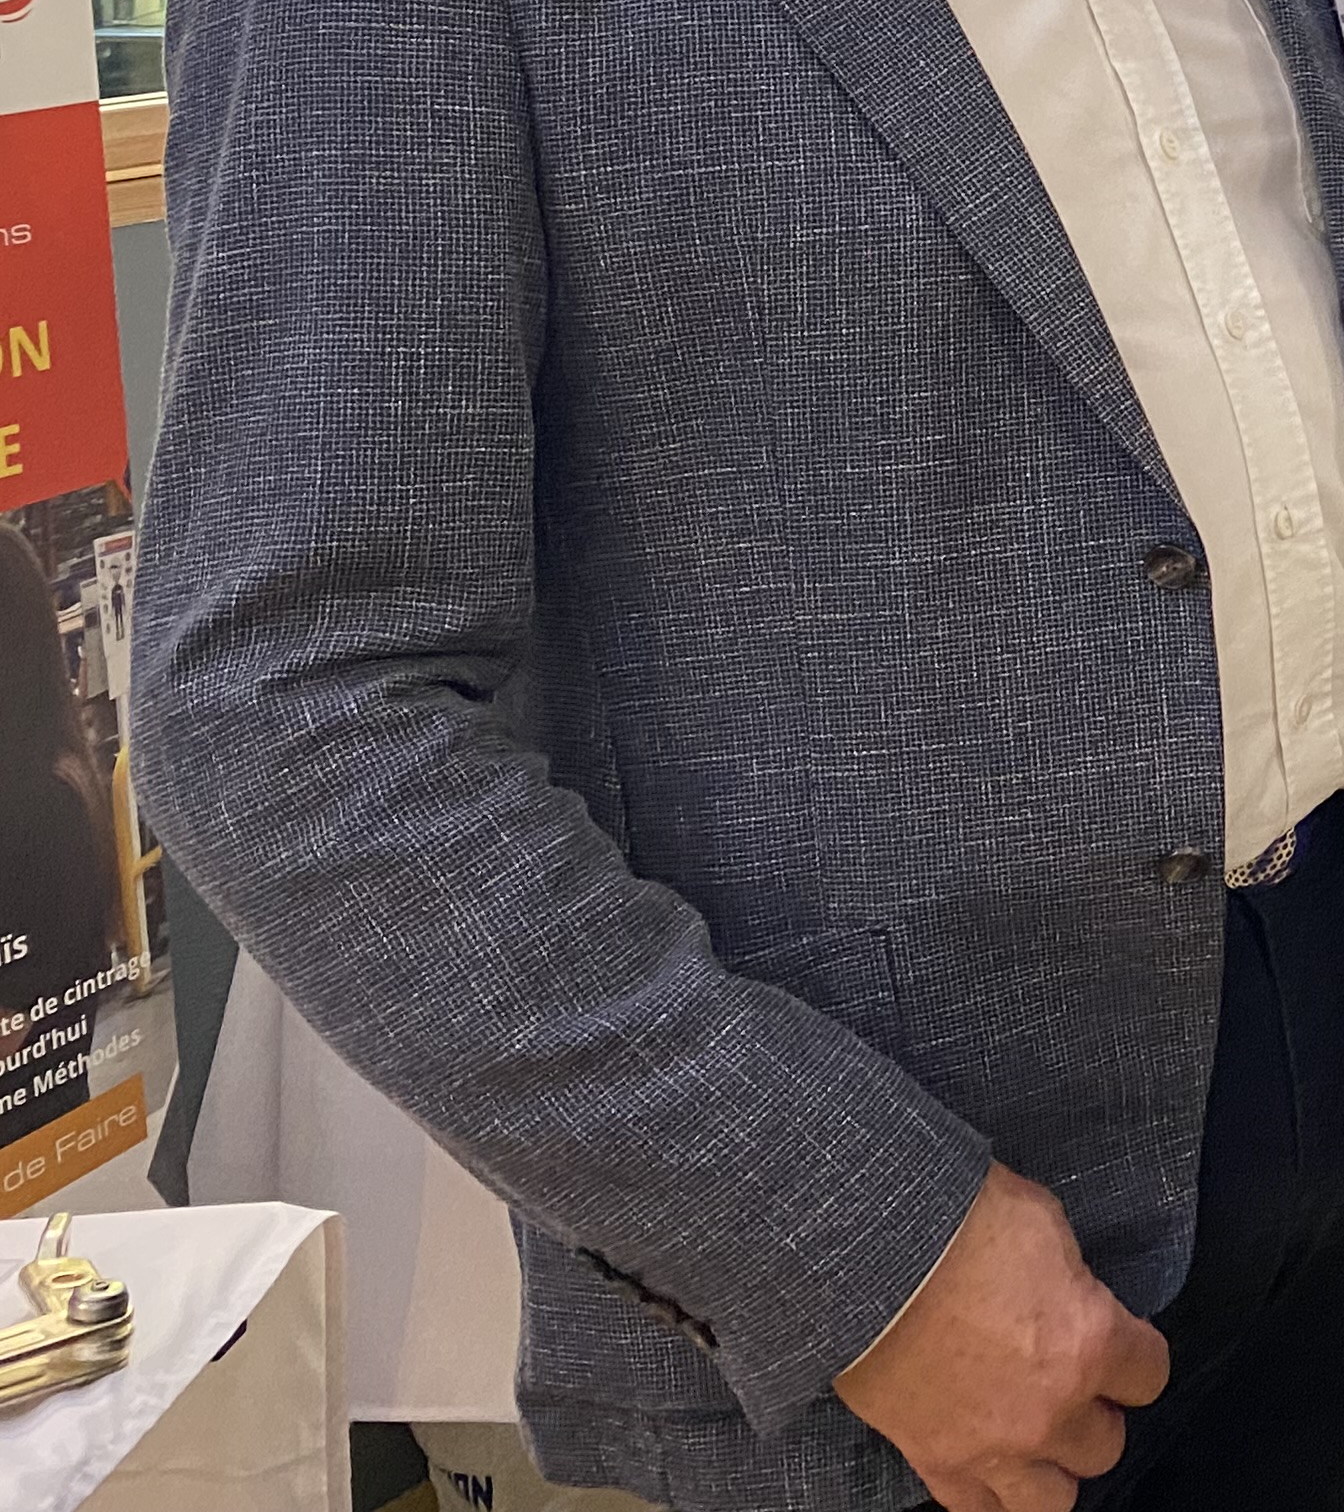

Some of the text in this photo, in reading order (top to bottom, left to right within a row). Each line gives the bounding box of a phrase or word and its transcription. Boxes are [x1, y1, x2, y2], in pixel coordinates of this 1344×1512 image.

[0, 320, 51, 378] N
[30, 997, 58, 1022] de
[64, 951, 151, 1007] cintrage
[33, 1028, 142, 1097] Méthodes
[3, 1105, 137, 1192] de Faire
